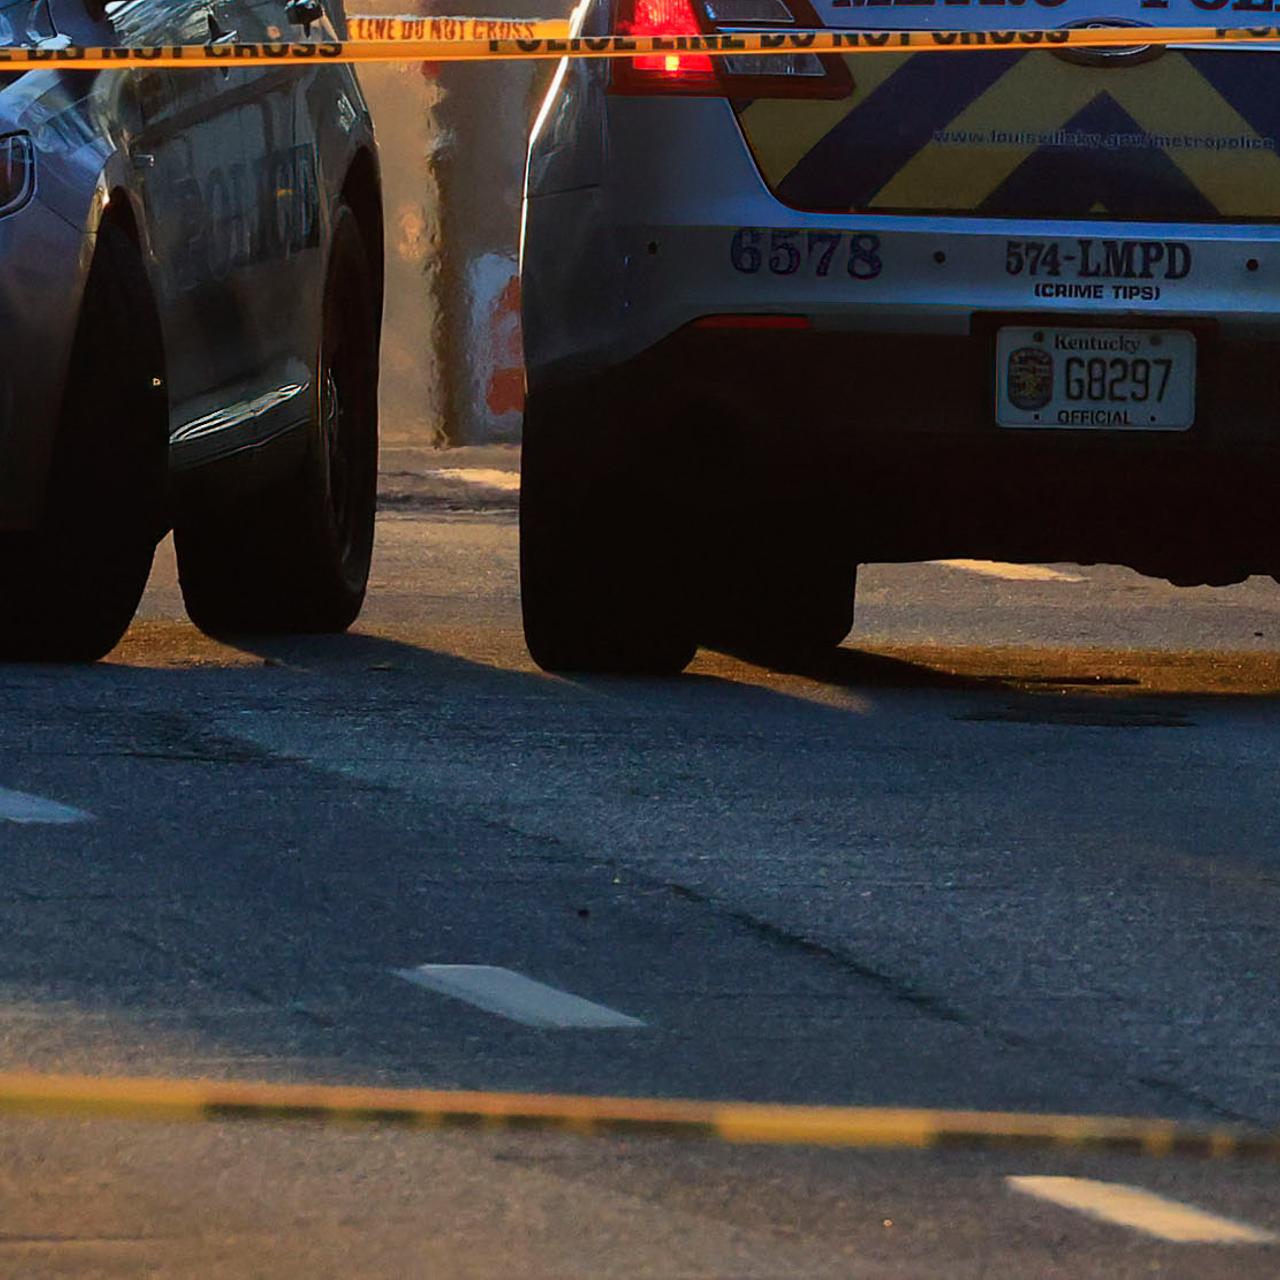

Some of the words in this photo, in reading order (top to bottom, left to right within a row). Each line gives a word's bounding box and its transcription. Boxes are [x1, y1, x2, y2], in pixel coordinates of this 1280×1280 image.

[358, 18, 394, 40] LINE
[400, 18, 424, 40] DO
[432, 18, 466, 40] NOT
[472, 21, 536, 40] CROSS
[731, 226, 883, 280] 6578
[1006, 239, 1192, 280] 574-LMPD
[1034, 282, 1104, 300] (CRIME
[1112, 285, 1161, 301] TIPS)
[1054, 334, 1141, 354] Kentucky
[1065, 356, 1173, 403] G8297
[1057, 410, 1131, 425] OFFICIAL
